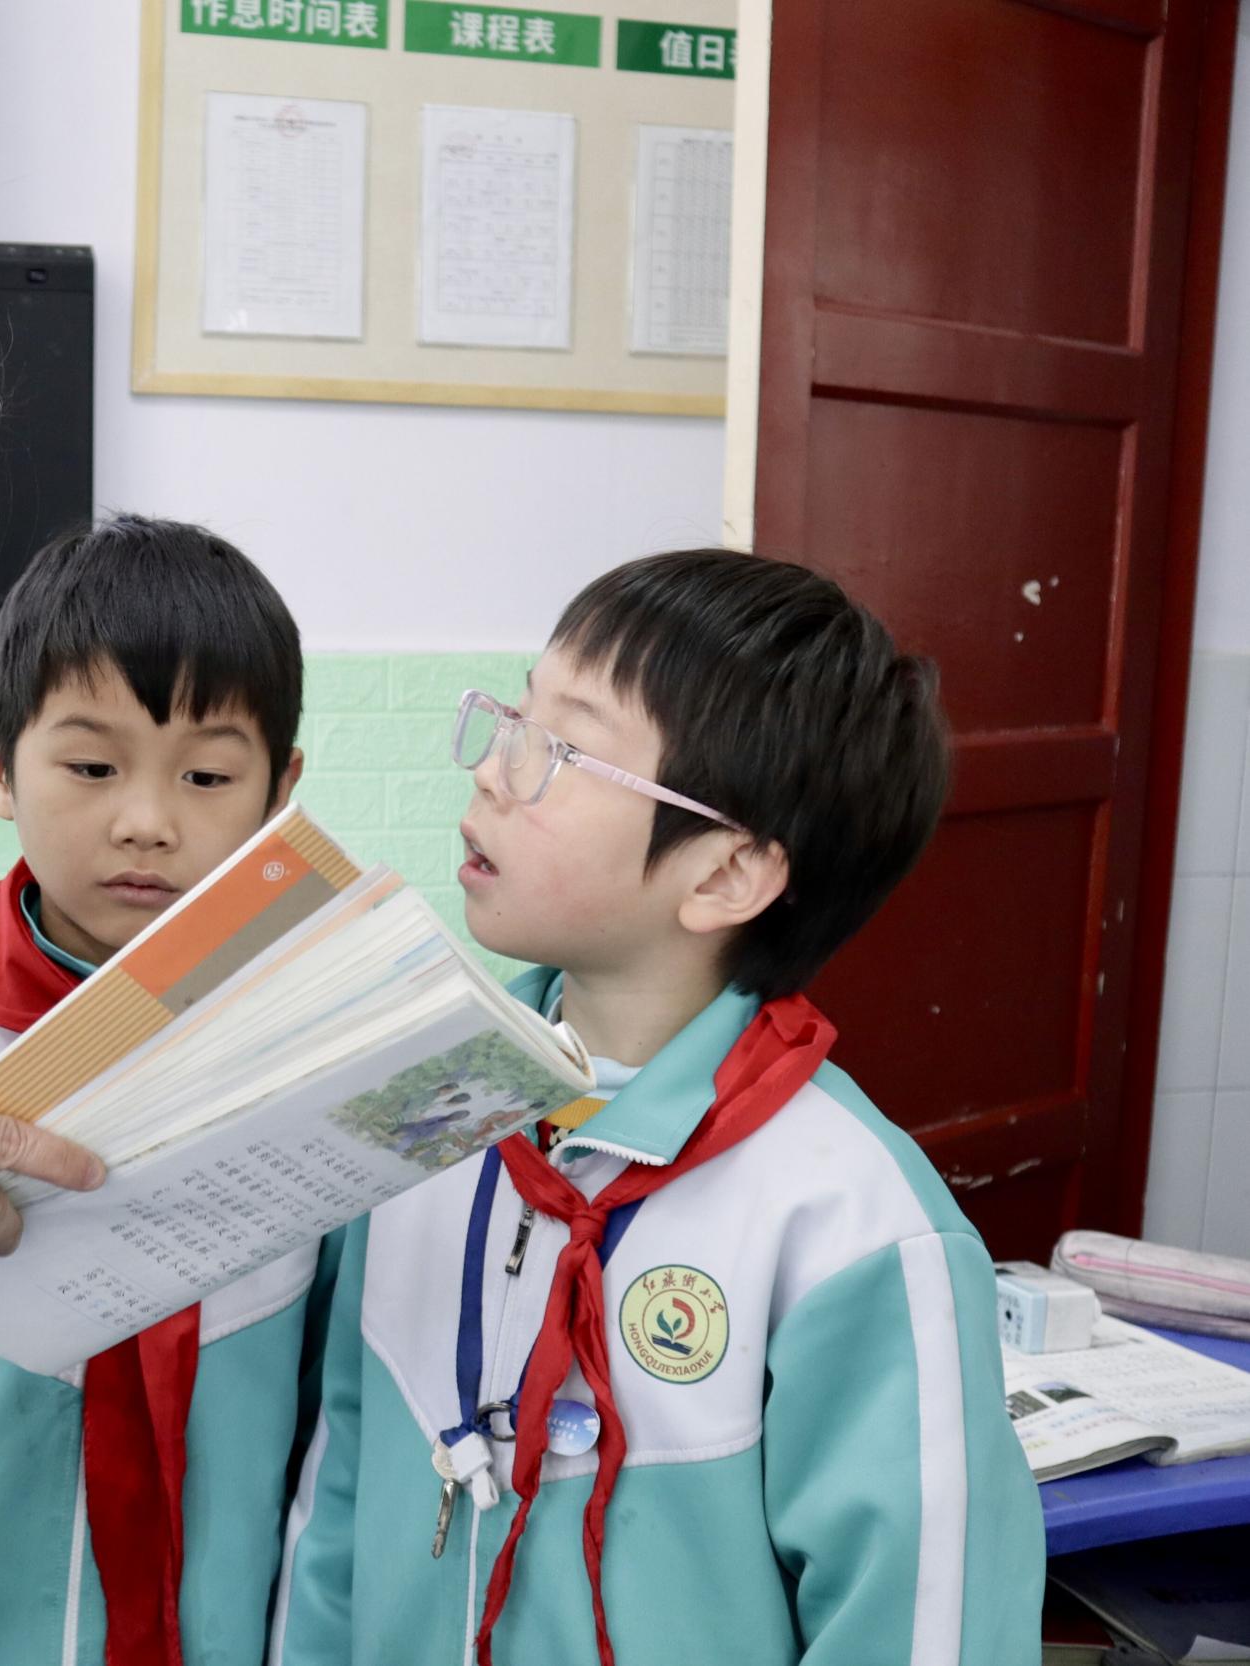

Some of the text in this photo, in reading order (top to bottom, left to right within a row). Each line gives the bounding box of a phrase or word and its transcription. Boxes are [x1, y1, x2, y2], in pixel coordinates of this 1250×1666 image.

[189, 0, 378, 38] 作息时间表
[449, 11, 555, 54] 课程表
[659, 29, 735, 72] 值日
